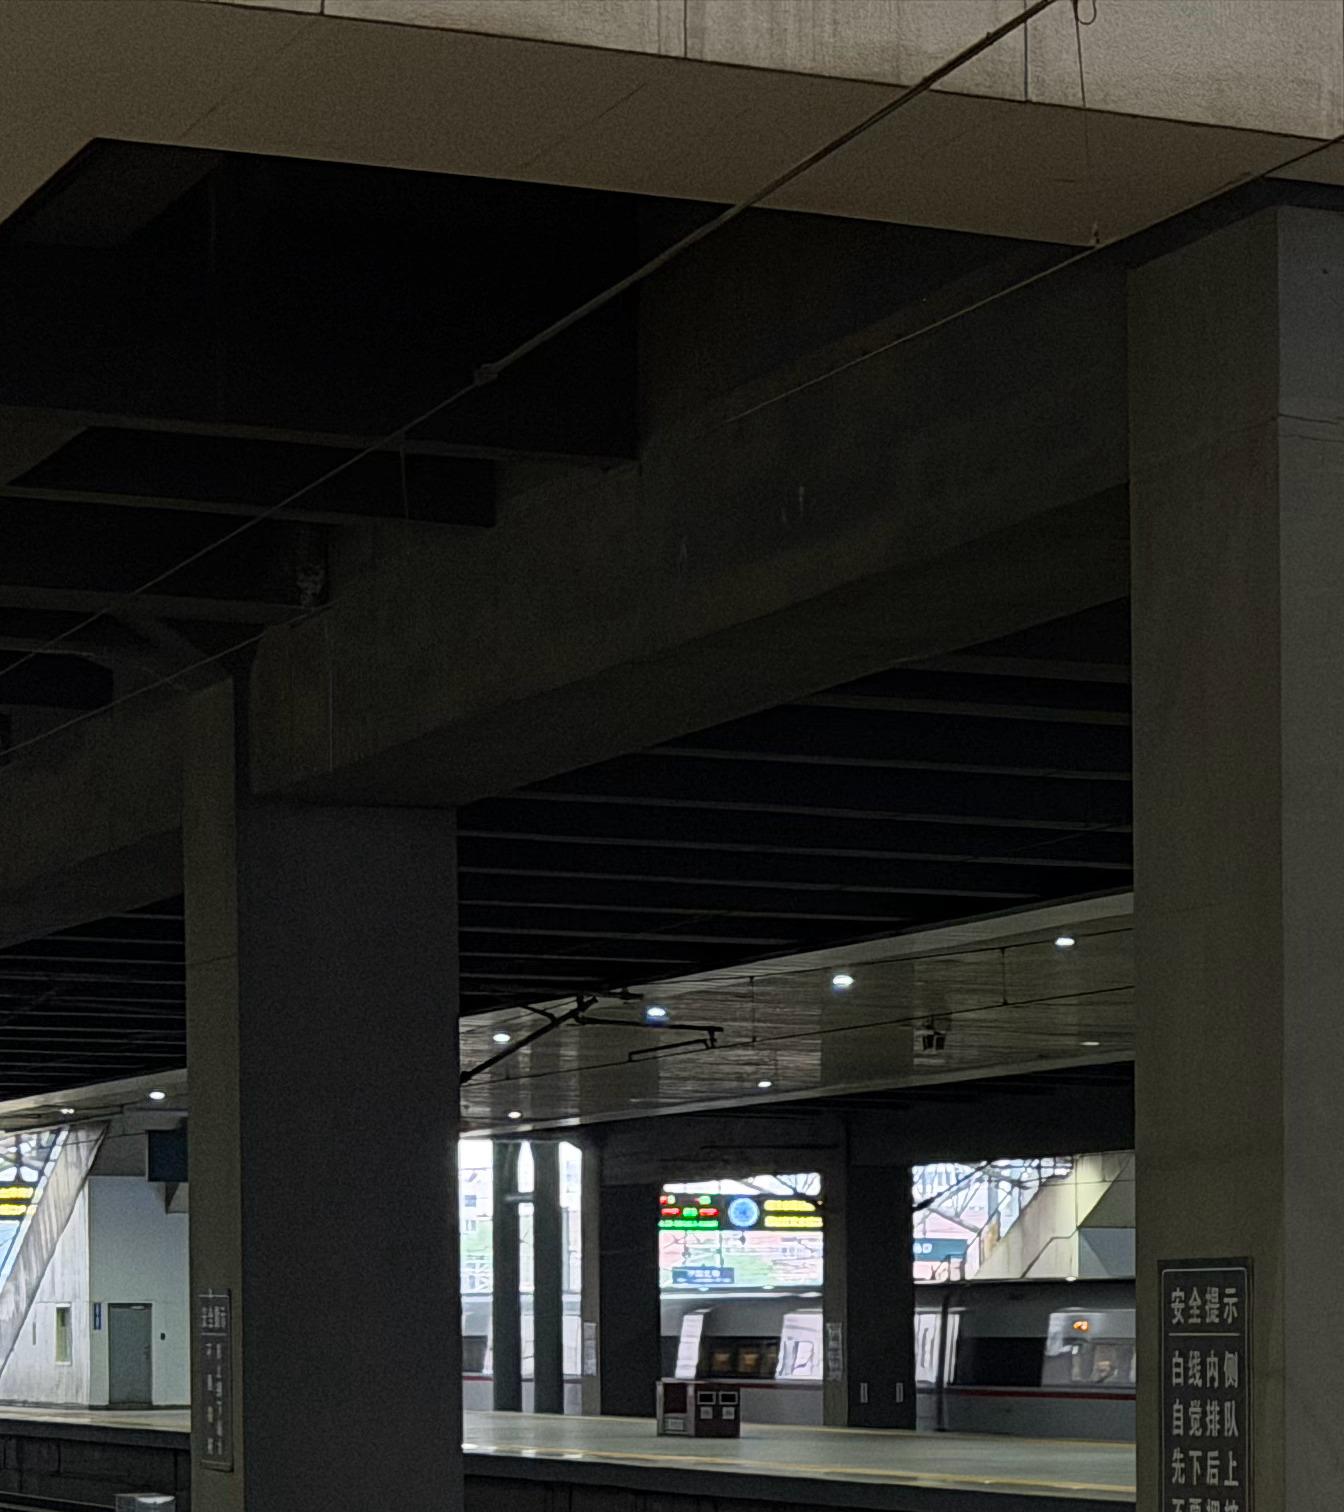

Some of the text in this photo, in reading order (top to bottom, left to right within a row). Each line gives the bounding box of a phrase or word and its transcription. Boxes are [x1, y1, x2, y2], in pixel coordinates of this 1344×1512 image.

[1170, 1286, 1240, 1325] 安全提示
[1171, 1350, 1240, 1389] 白线内侧
[1171, 1398, 1240, 1438] 自觉排队
[1171, 1448, 1240, 1487] 先下后上
